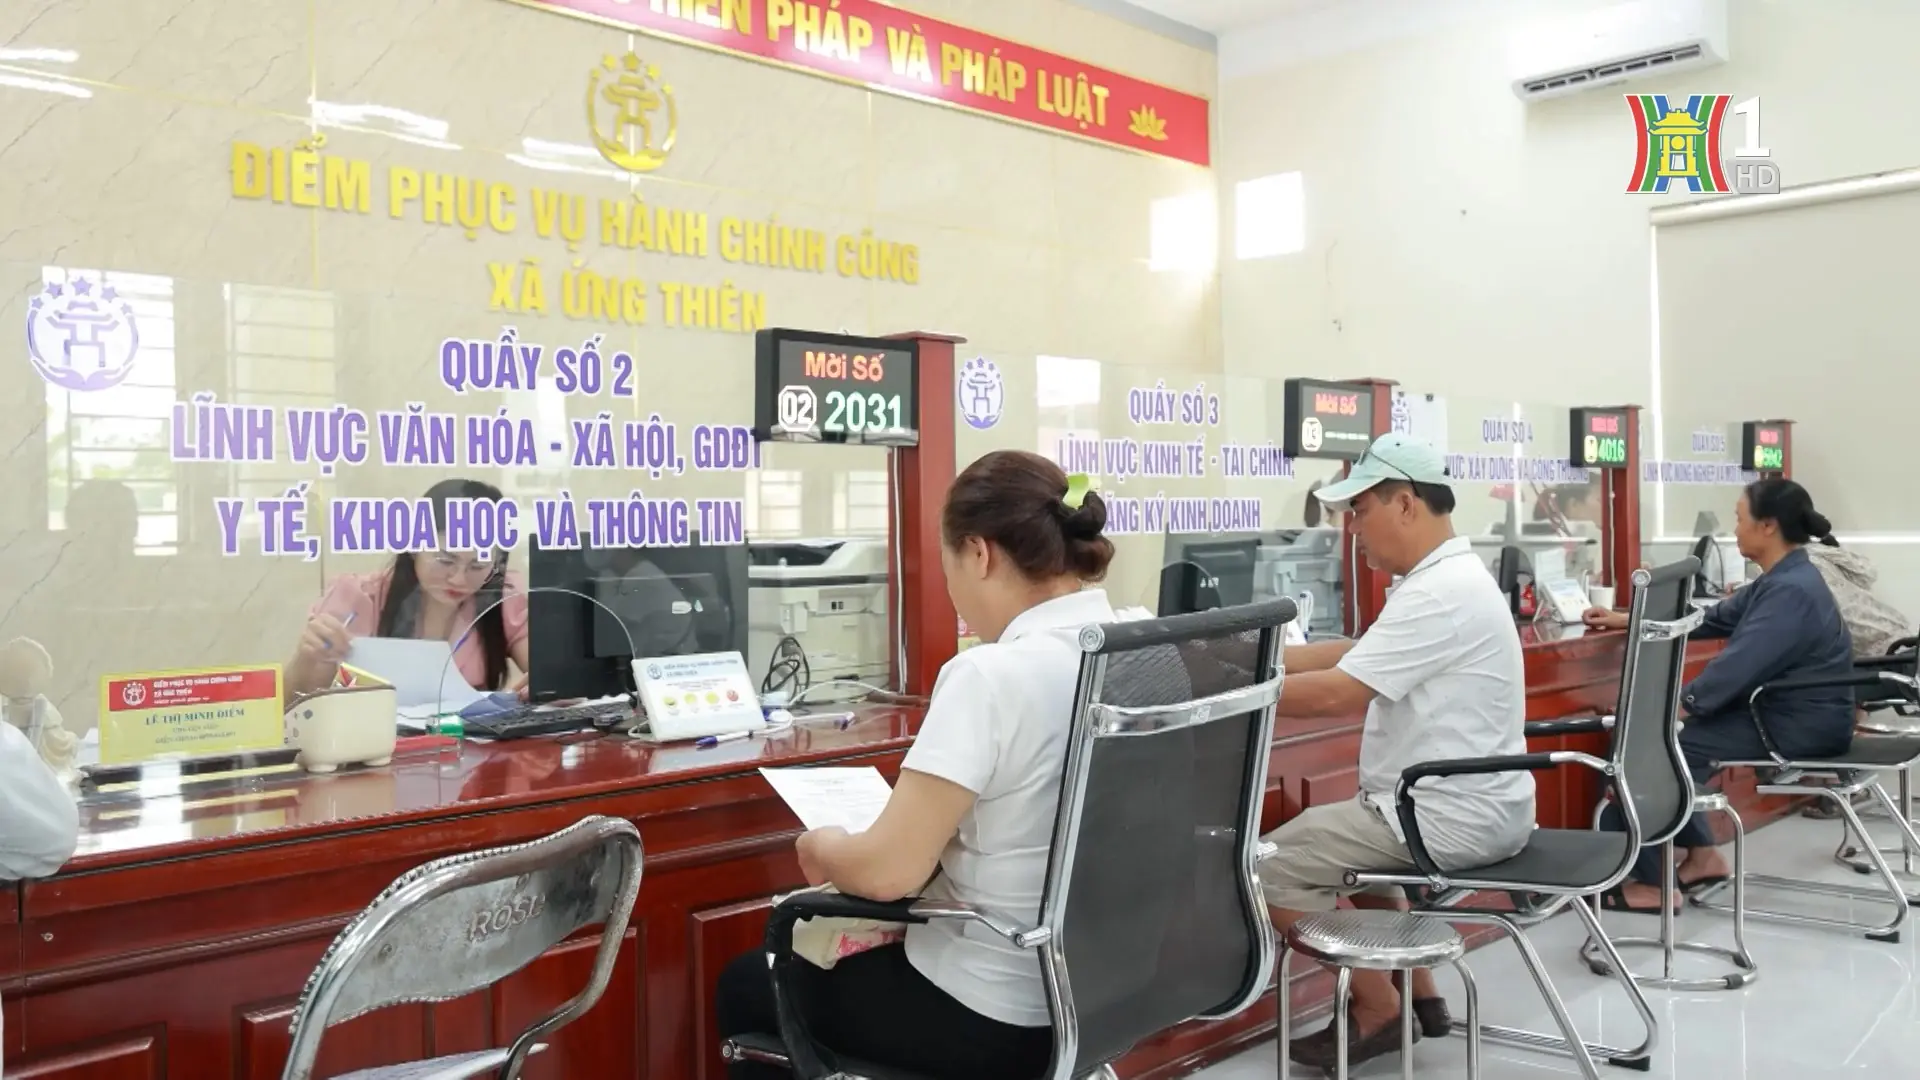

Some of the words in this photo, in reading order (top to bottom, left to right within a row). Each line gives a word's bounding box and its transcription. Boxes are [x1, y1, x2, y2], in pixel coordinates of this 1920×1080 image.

[767, 0, 873, 63] PHÁP
[886, 23, 933, 84] VÀ
[941, 42, 1027, 103] PHÁP
[1036, 69, 1109, 129] LUẬT
[231, 133, 371, 215] ĐIỂM
[389, 167, 518, 241] PHỤC
[531, 186, 587, 252] VỤ
[600, 196, 708, 258] HÀNH
[719, 214, 826, 274] CHÍNH
[836, 228, 919, 284] CÔNG
[488, 256, 546, 314] XÃ
[560, 257, 647, 326] ỨNG
[658, 279, 767, 332] THIÊN
[442, 329, 541, 392] QUẦY
[556, 336, 604, 394] SỐ
[613, 353, 633, 396] 2
[805, 351, 847, 379] Mời
[852, 353, 885, 382] Số
[782, 390, 812, 425] 02
[824, 390, 905, 433] 2031
[1129, 381, 1175, 423] QUẦY
[1182, 384, 1205, 425] SỐ
[1209, 396, 1219, 425] 3
[172, 396, 273, 460] LĨNH
[288, 409, 366, 474] VỰC
[382, 405, 456, 464] VĂN
[468, 409, 537, 466] HÓA
[550, 441, 562, 453] -
[573, 413, 616, 467] XÃ
[626, 415, 684, 478] HỘI,
[1105, 440, 1138, 482] VỰC
[1144, 444, 1182, 475] KINH
[1187, 434, 1204, 476] TẾ
[1223, 441, 1244, 476] TÀI
[1599, 437, 1626, 463] 4016
[220, 500, 240, 553] Y
[259, 483, 319, 559] TẾ,
[333, 500, 437, 550] KHOA
[449, 501, 518, 559] HỌC
[536, 491, 580, 548] VÀ
[588, 492, 688, 546] THÔNG
[698, 501, 742, 543] TIN
[1104, 492, 1139, 533] ĂNG
[1145, 492, 1165, 532] KÝ
[1169, 500, 1207, 531] KINH
[1212, 500, 1261, 531] DOANH
